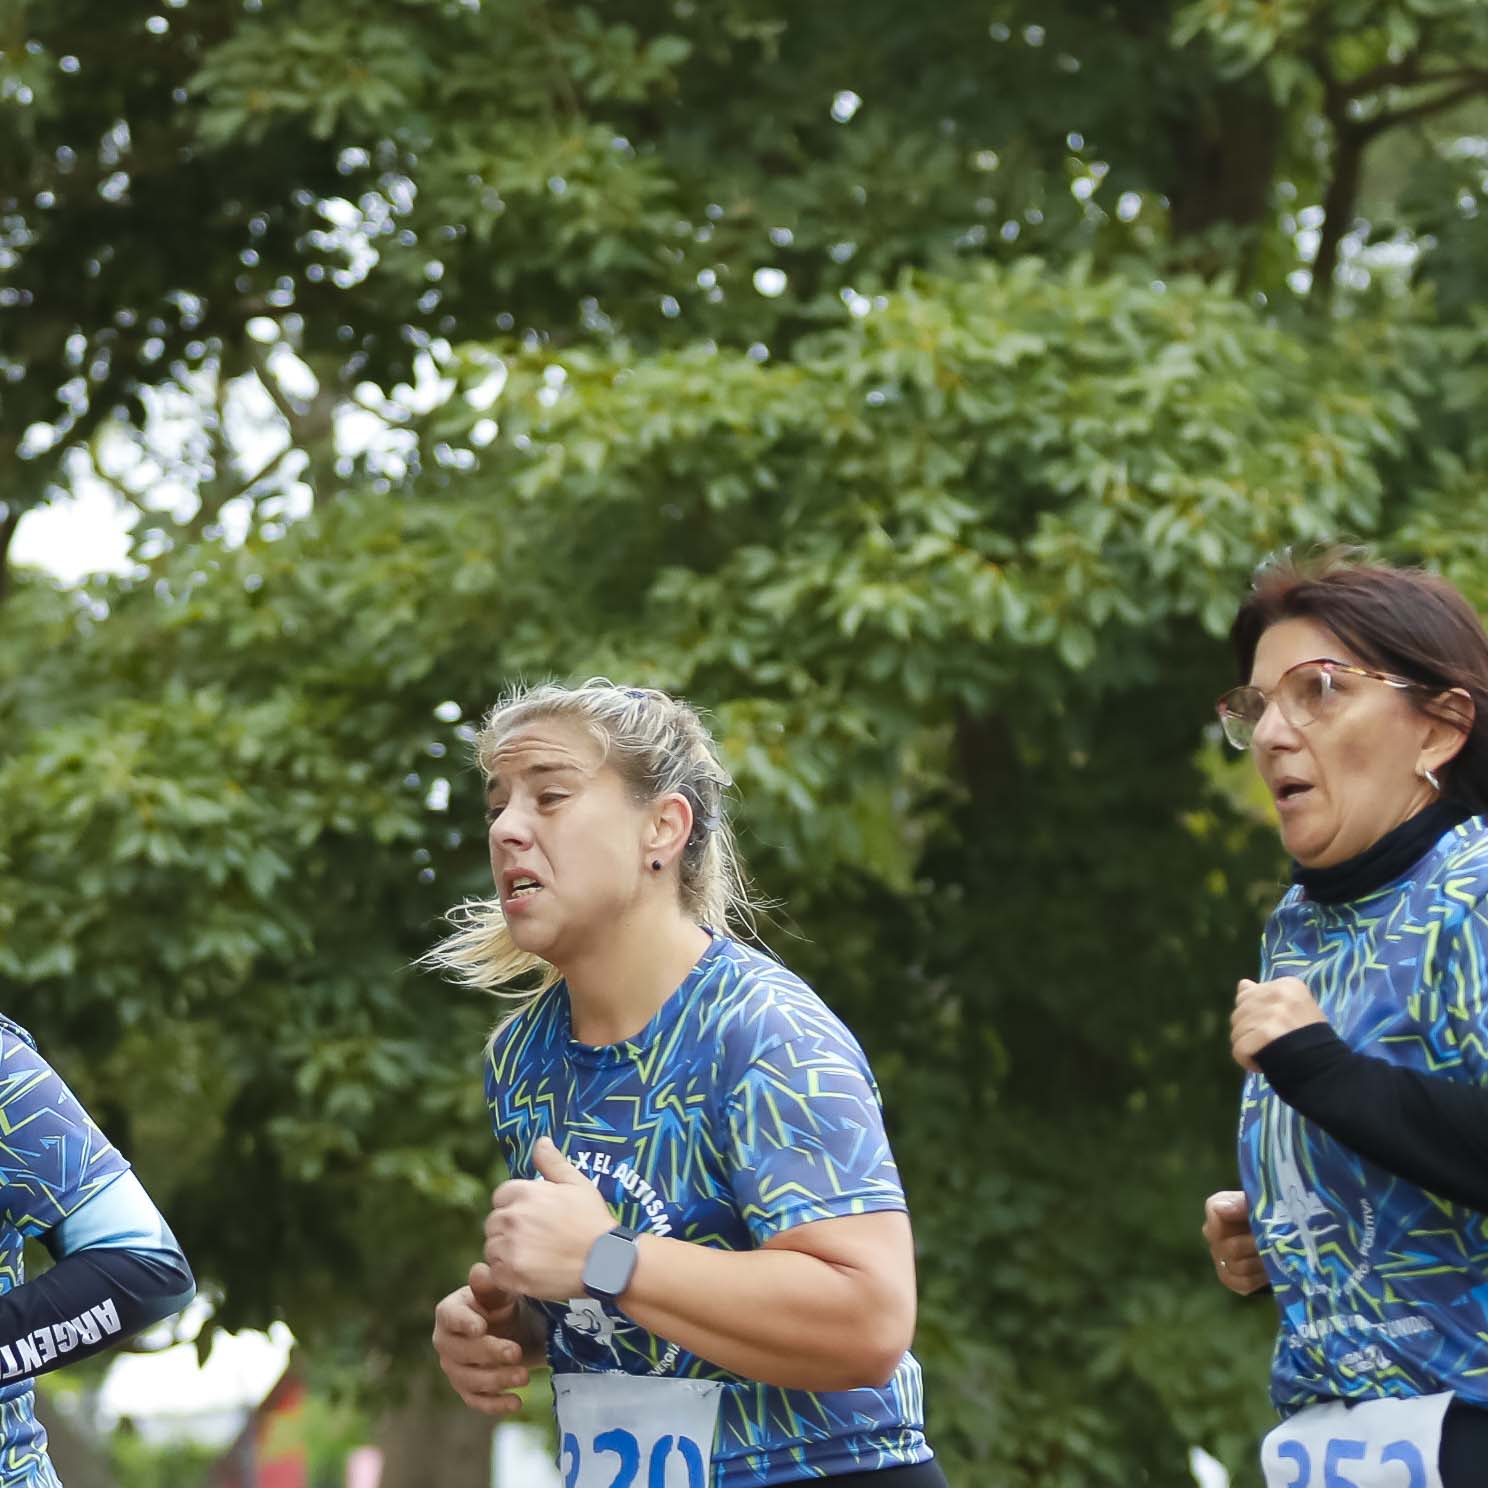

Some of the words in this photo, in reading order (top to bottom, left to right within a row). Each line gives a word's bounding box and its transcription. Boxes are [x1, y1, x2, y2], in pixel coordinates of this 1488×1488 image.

[576, 1152, 592, 1170] X
[593, 1152, 612, 1175] EL
[612, 1163, 672, 1237] AUTISM
